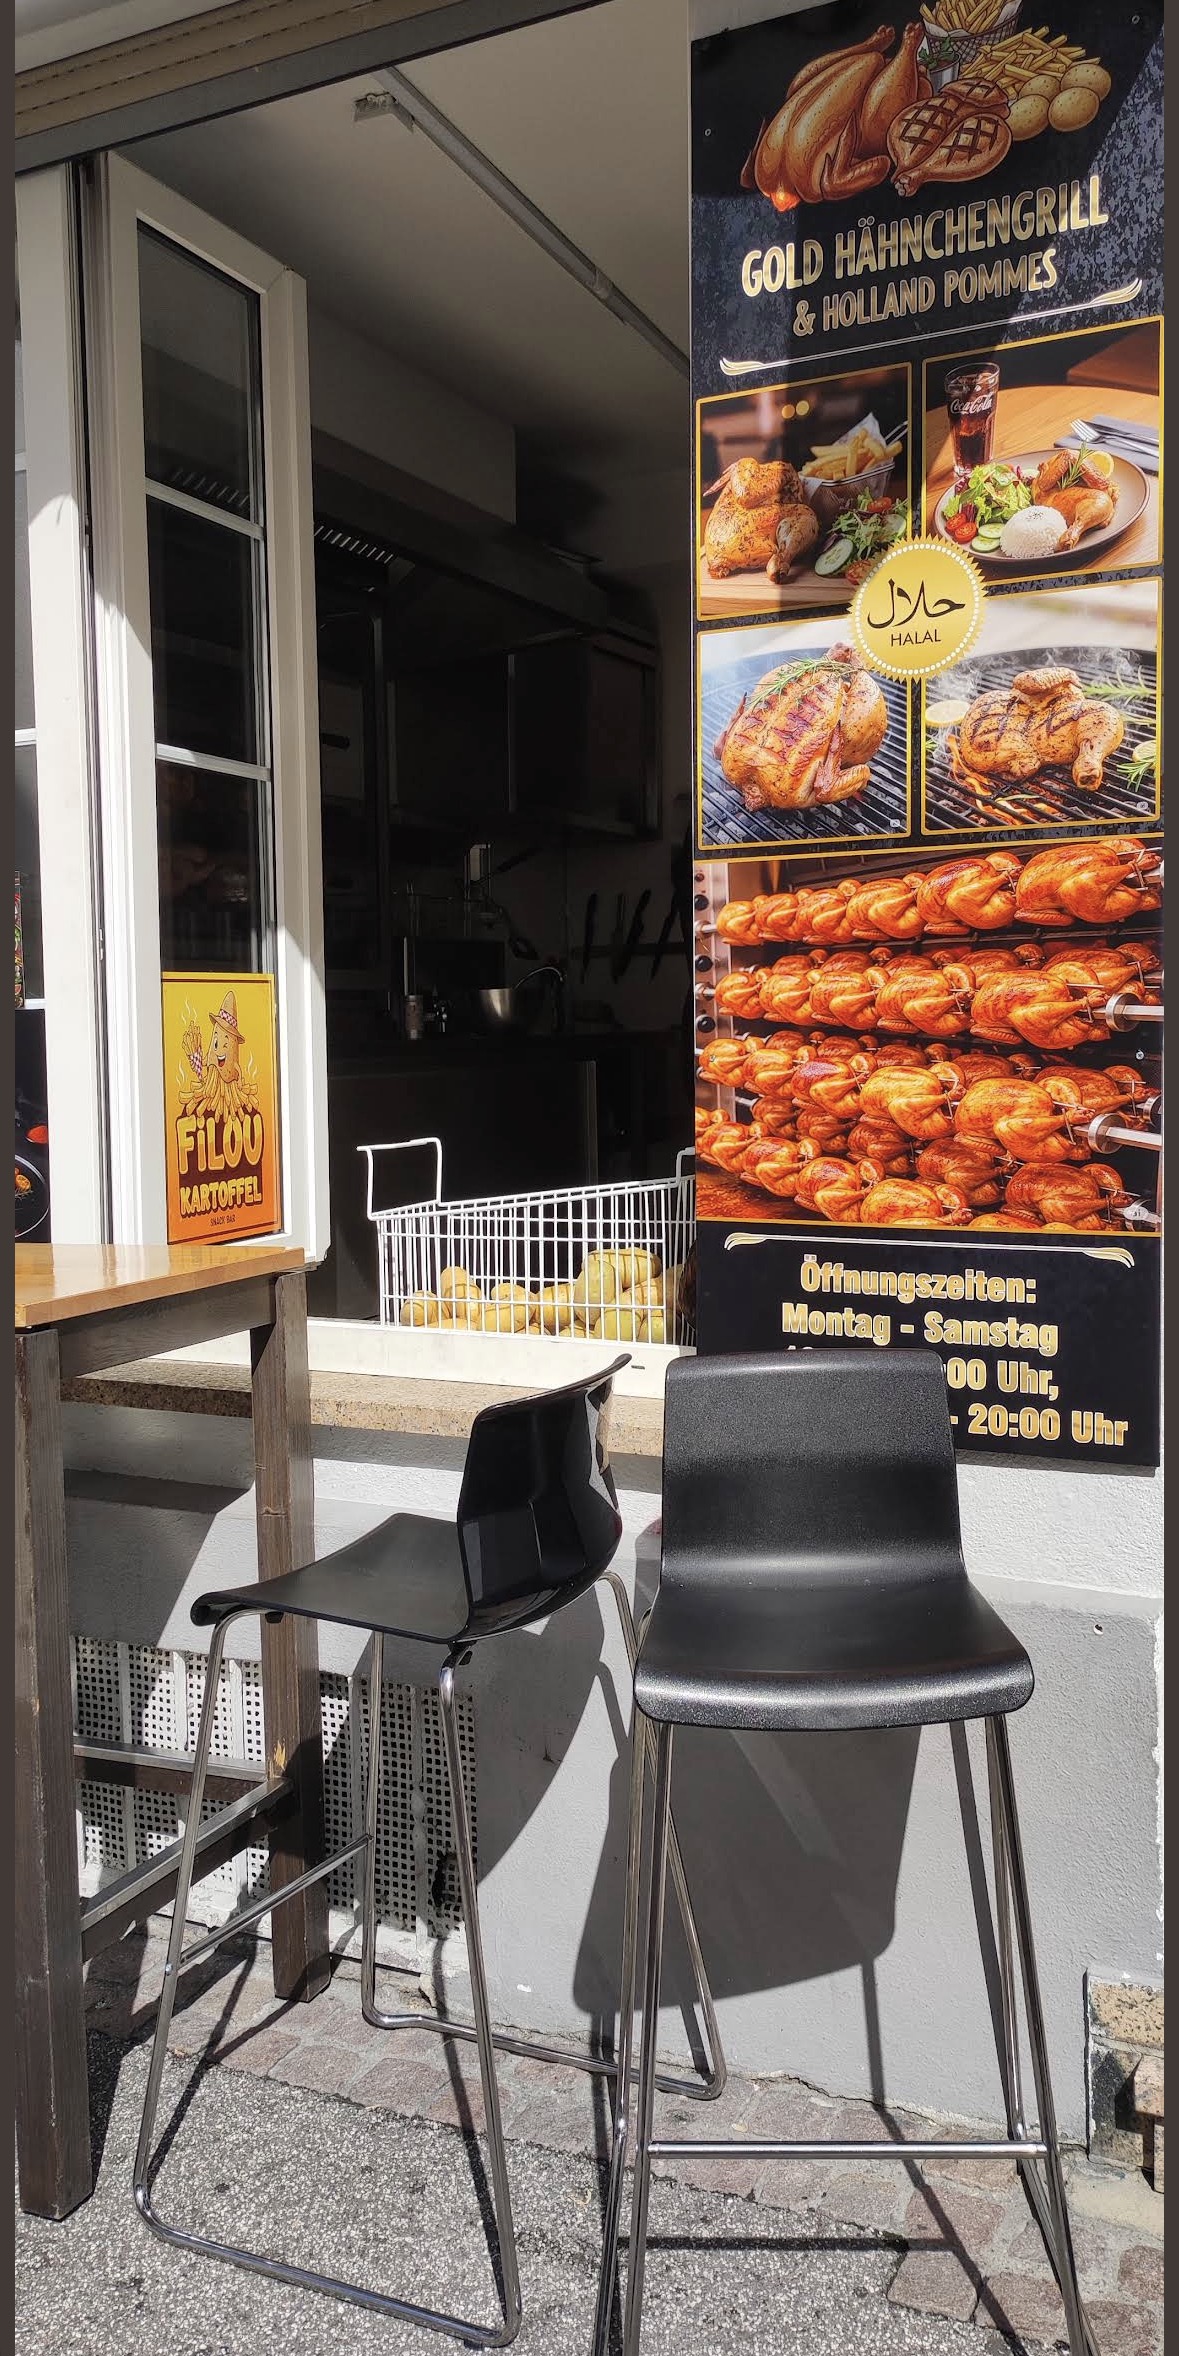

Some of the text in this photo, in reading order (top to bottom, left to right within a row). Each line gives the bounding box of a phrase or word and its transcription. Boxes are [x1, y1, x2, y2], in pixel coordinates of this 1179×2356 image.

[741, 175, 1109, 298] GOLD HÄHNCHENGRILL
[792, 248, 1057, 337] & HOLLAND POMMES
[867, 578, 966, 629] حلال
[891, 629, 941, 647] HALAL
[179, 1176, 262, 1215] KARTOFFEL
[800, 1254, 1037, 1304] Öffnungszeiten:
[781, 1302, 1059, 1357] Montag - Samstag
[997, 1360, 1059, 1401] Uhr,
[968, 1403, 1060, 1441] 20:00
[1071, 1410, 1129, 1446] Uhr
